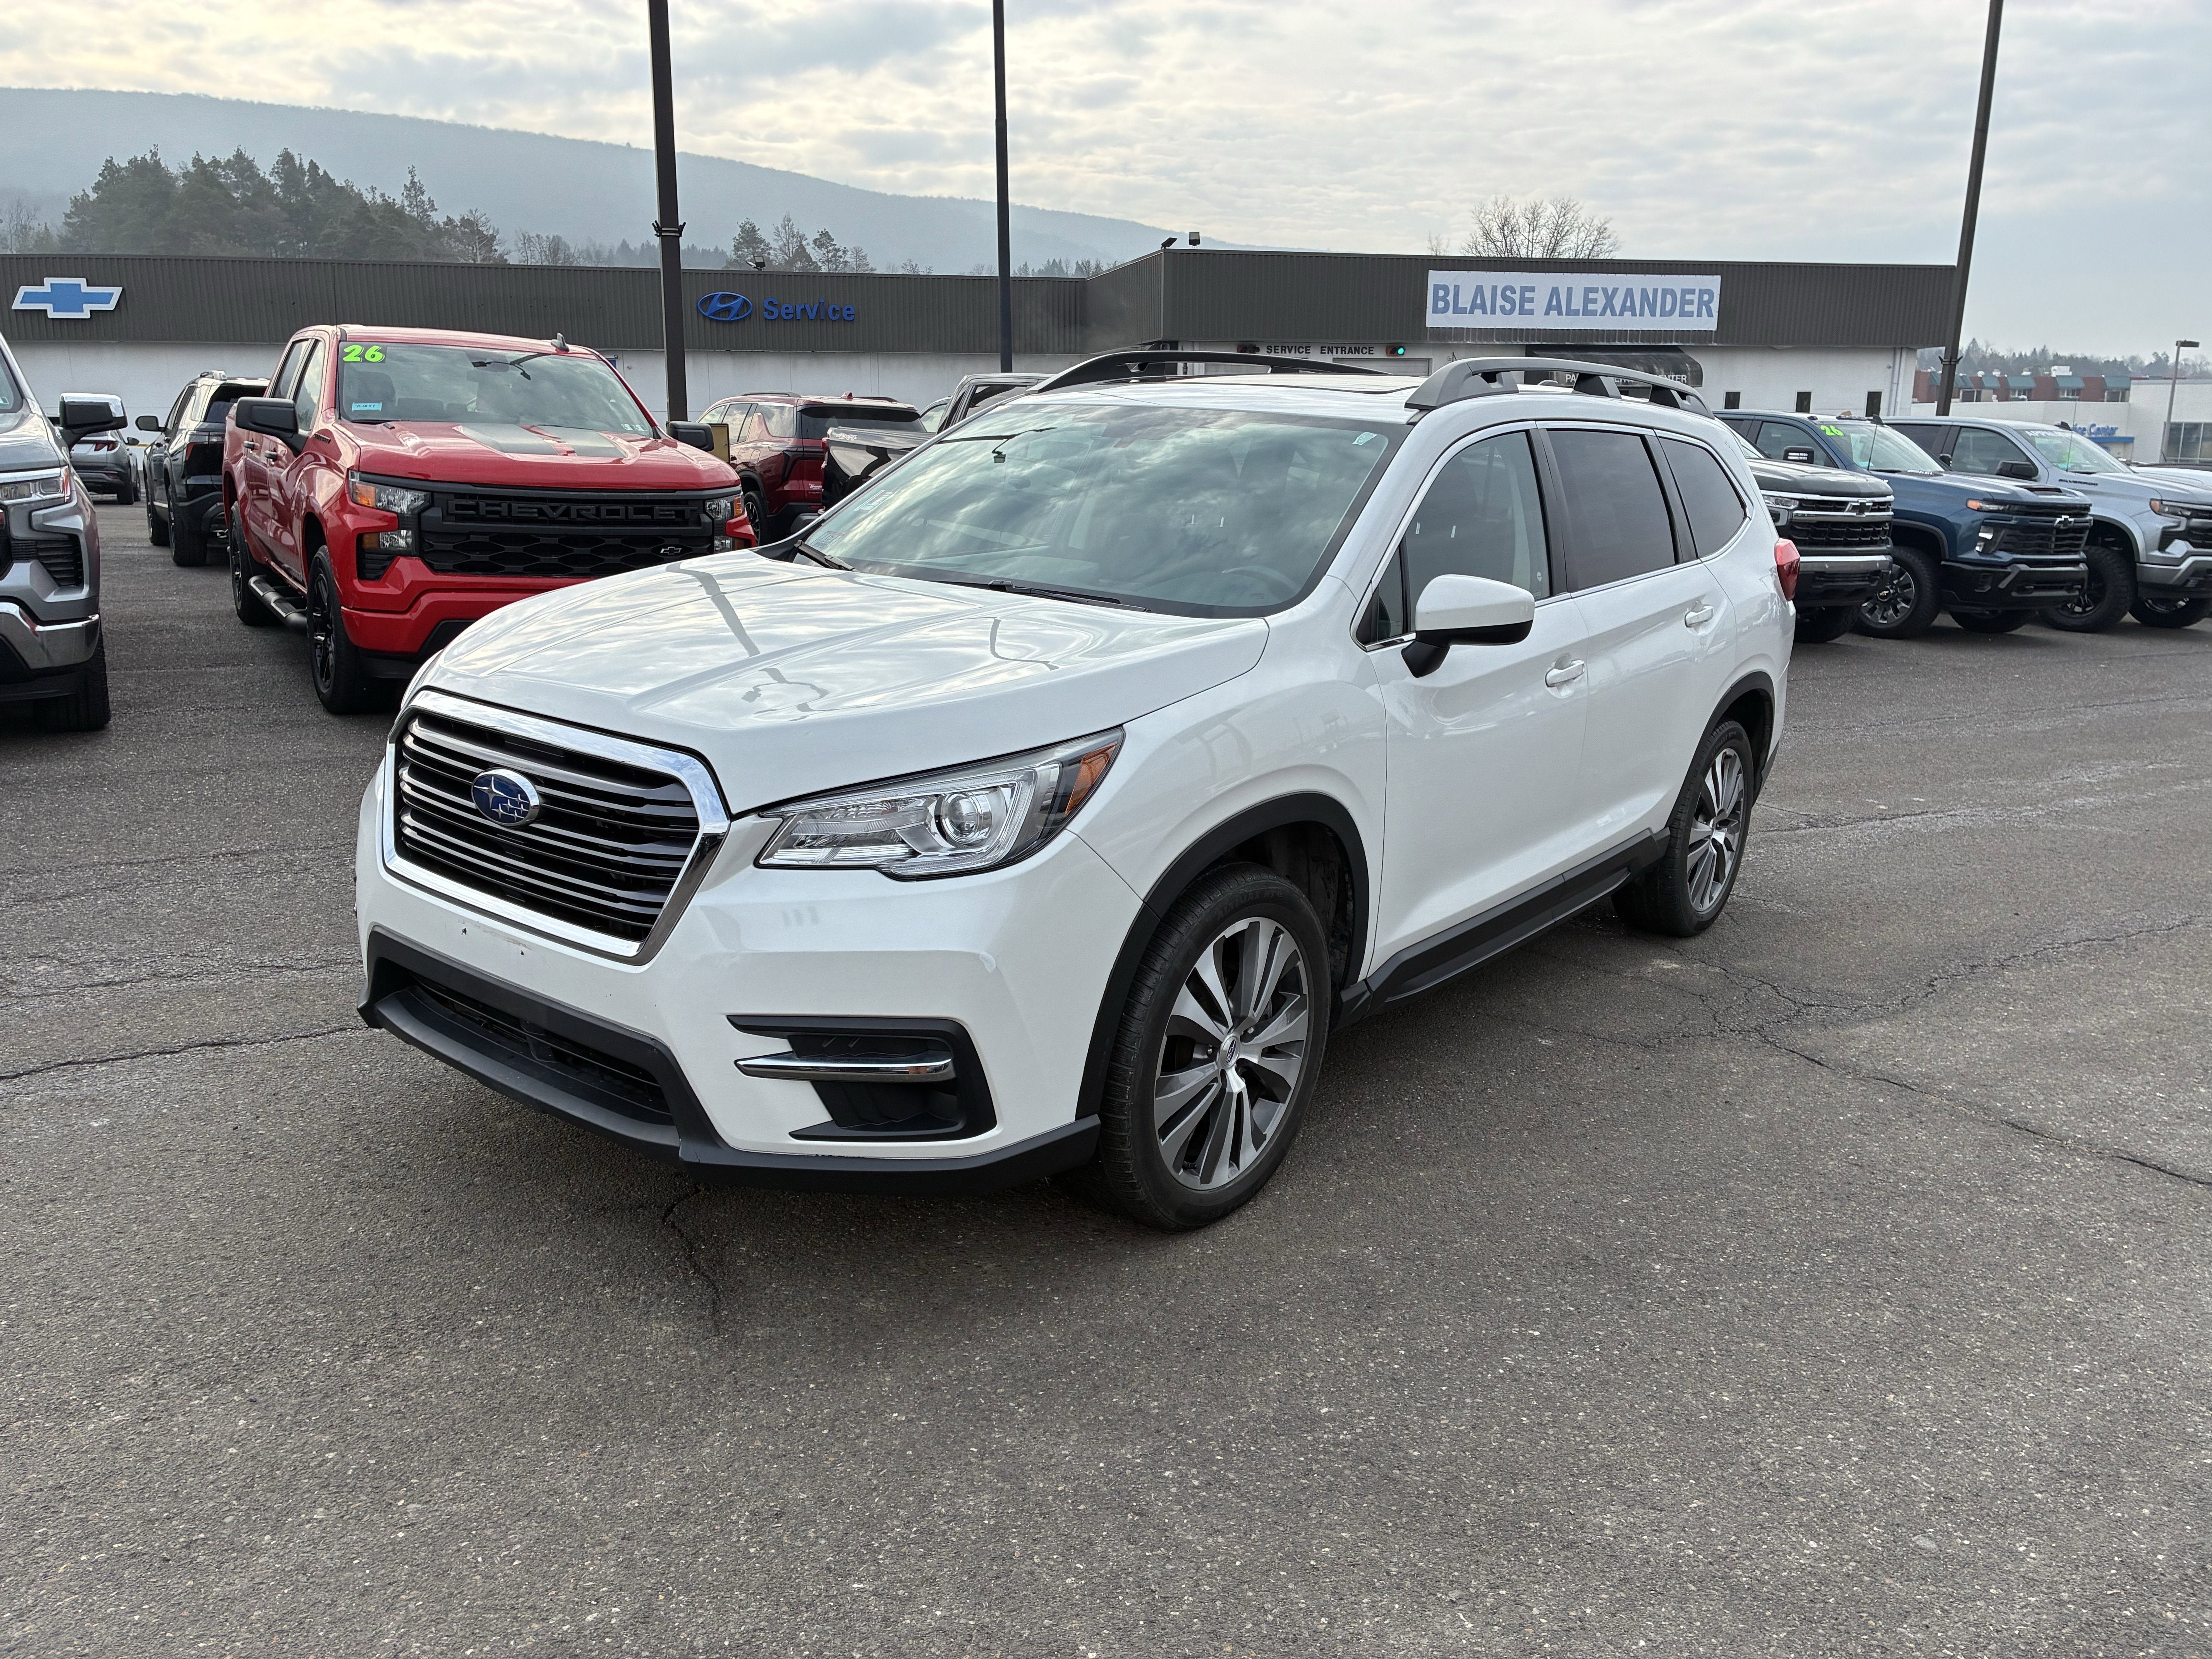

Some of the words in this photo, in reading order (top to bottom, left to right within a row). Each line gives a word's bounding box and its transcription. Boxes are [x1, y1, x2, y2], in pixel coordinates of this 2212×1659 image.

[763, 297, 855, 321] Service
[1432, 283, 1535, 316] BLAISE
[1544, 286, 1714, 318] ALEXANDER
[343, 345, 385, 362] 26
[1266, 345, 1311, 354] SERVICE
[1320, 346, 1374, 355] ENTRANCE
[1820, 425, 1844, 436] 26
[448, 500, 697, 520] CHEVROLET
